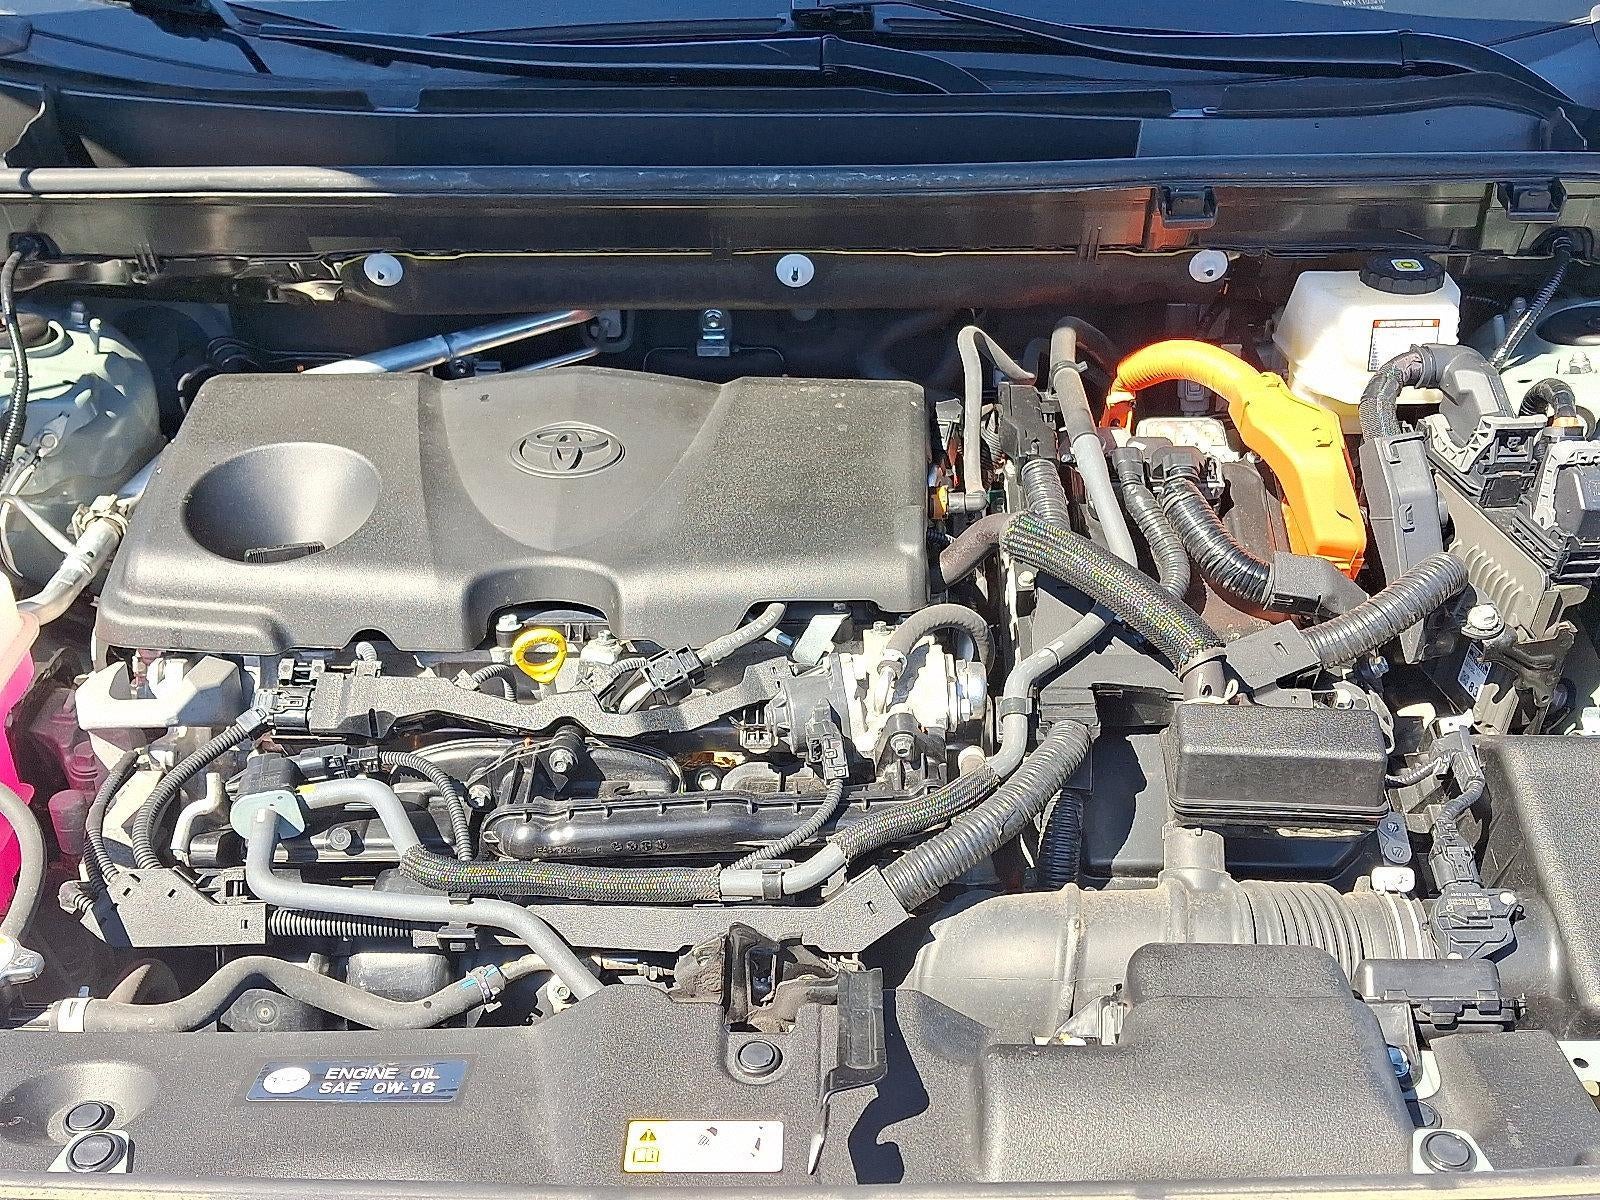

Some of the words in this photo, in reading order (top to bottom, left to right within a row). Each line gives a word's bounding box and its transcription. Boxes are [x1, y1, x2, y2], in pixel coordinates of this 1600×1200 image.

[324, 1067, 400, 1080] ENGINE
[410, 1067, 440, 1080] OIL
[318, 1082, 362, 1094] SAE
[372, 1082, 436, 1094] 0W-16
